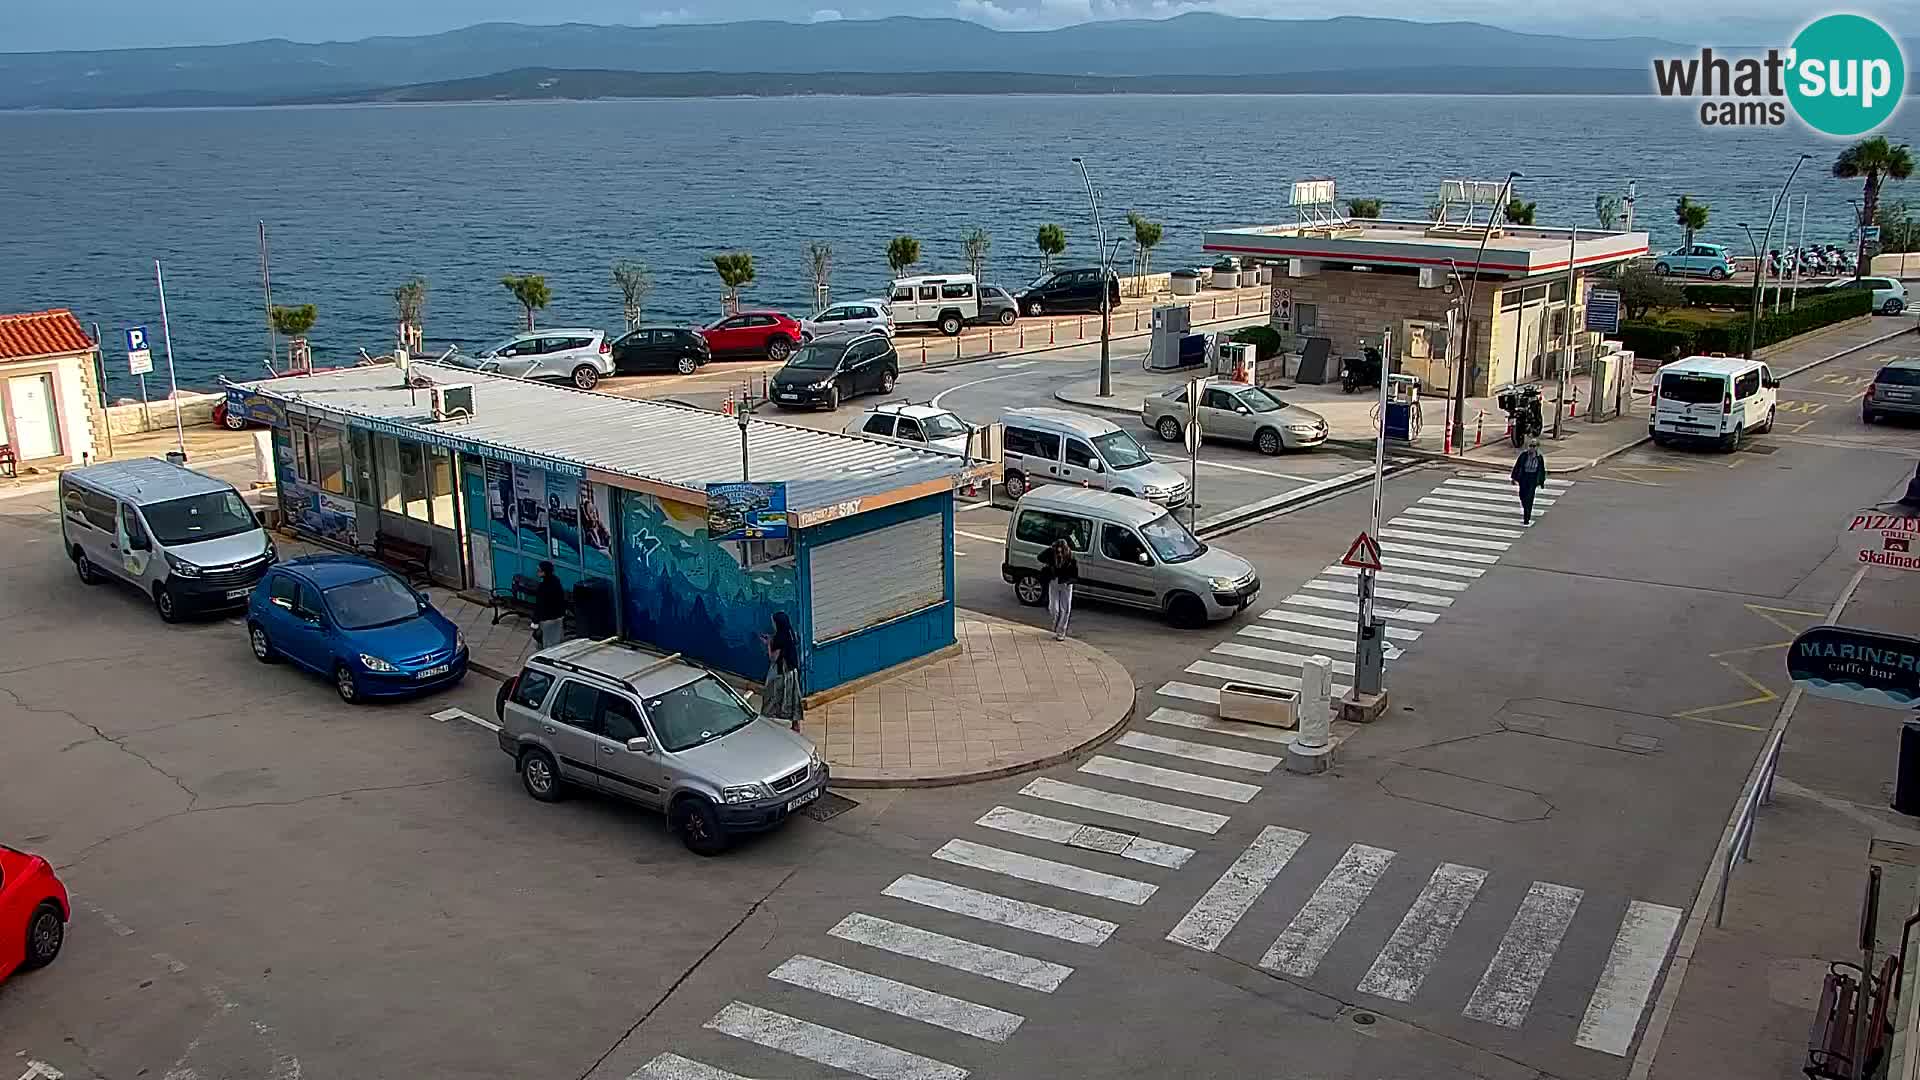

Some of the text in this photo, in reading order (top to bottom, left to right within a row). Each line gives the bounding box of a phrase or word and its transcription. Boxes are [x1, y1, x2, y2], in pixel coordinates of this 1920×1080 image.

[131, 330, 144, 349] P
[396, 425, 437, 444] AUTOBUSNA
[437, 438, 468, 452] POSTAJA
[480, 445, 495, 457] BUS
[495, 449, 527, 464] STATION
[529, 456, 555, 471] TICKET
[556, 463, 583, 476] OFFICE
[1881, 530, 1916, 540] GRILL
[1828, 663, 1896, 679] caffe bar
